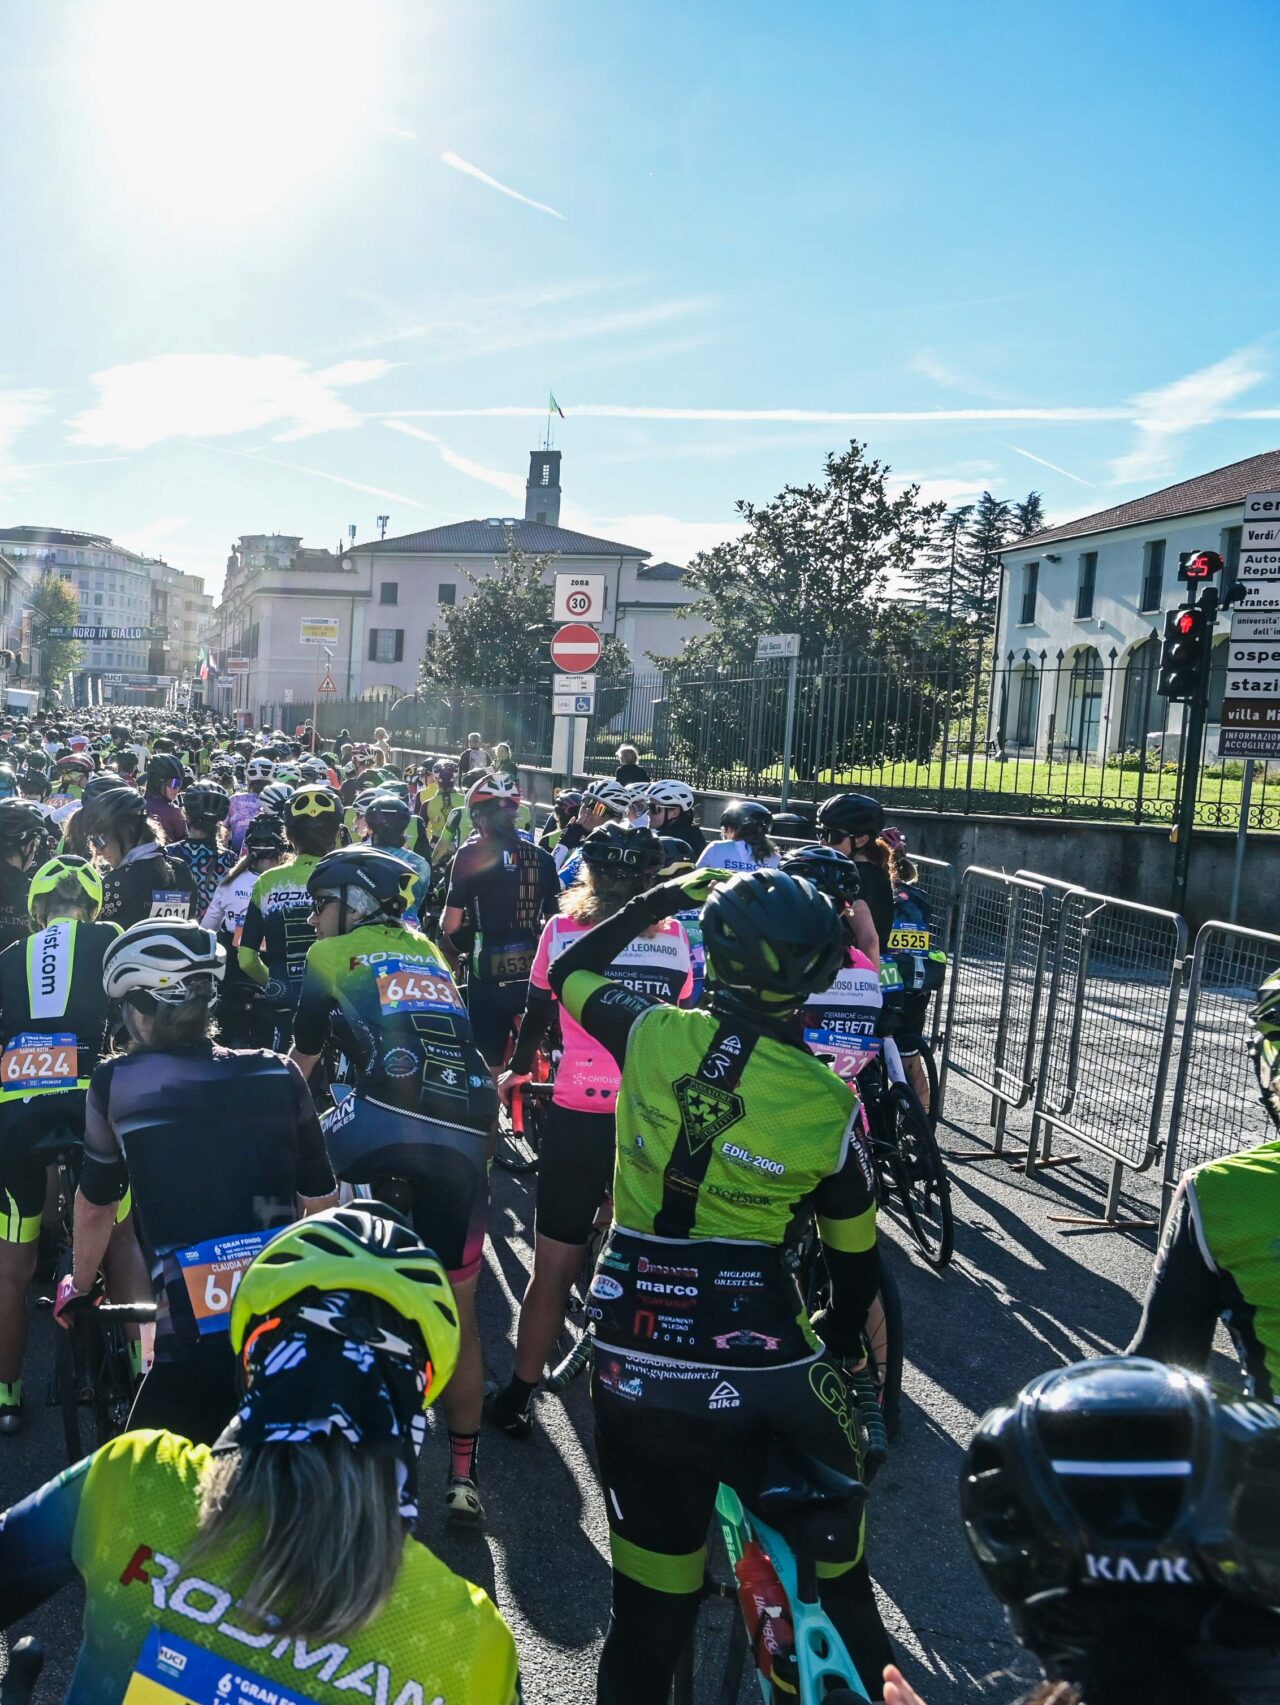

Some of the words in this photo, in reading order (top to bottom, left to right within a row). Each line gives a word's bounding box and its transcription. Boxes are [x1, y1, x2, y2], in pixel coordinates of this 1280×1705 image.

[571, 597, 586, 610] 30
[72, 627, 96, 638] NORD
[98, 627, 108, 638] IN
[111, 627, 141, 639] GIALLO
[1228, 708, 1260, 721] villa
[891, 934, 926, 949] 6525
[631, 943, 678, 957] LEONARDO
[497, 955, 534, 973] 653
[604, 970, 638, 979] RAMICHE
[387, 978, 454, 1004] 6433
[719, 1044, 740, 1055] alka
[7, 1052, 70, 1079] 6424
[721, 1143, 785, 1176] EDIL-2000
[707, 1185, 773, 1206] EXCELSIOR
[222, 1240, 240, 1249] GRAN
[211, 1259, 241, 1273] CLAUDIA
[636, 1279, 699, 1297] marco
[714, 1278, 748, 1287] ORESTE
[625, 1362, 720, 1380] www.gspassatore.it
[708, 1399, 740, 1409] alka
[1086, 1553, 1194, 1583] KASK
[162, 1650, 185, 1667] UCI
[240, 1680, 278, 1704] GRAN
